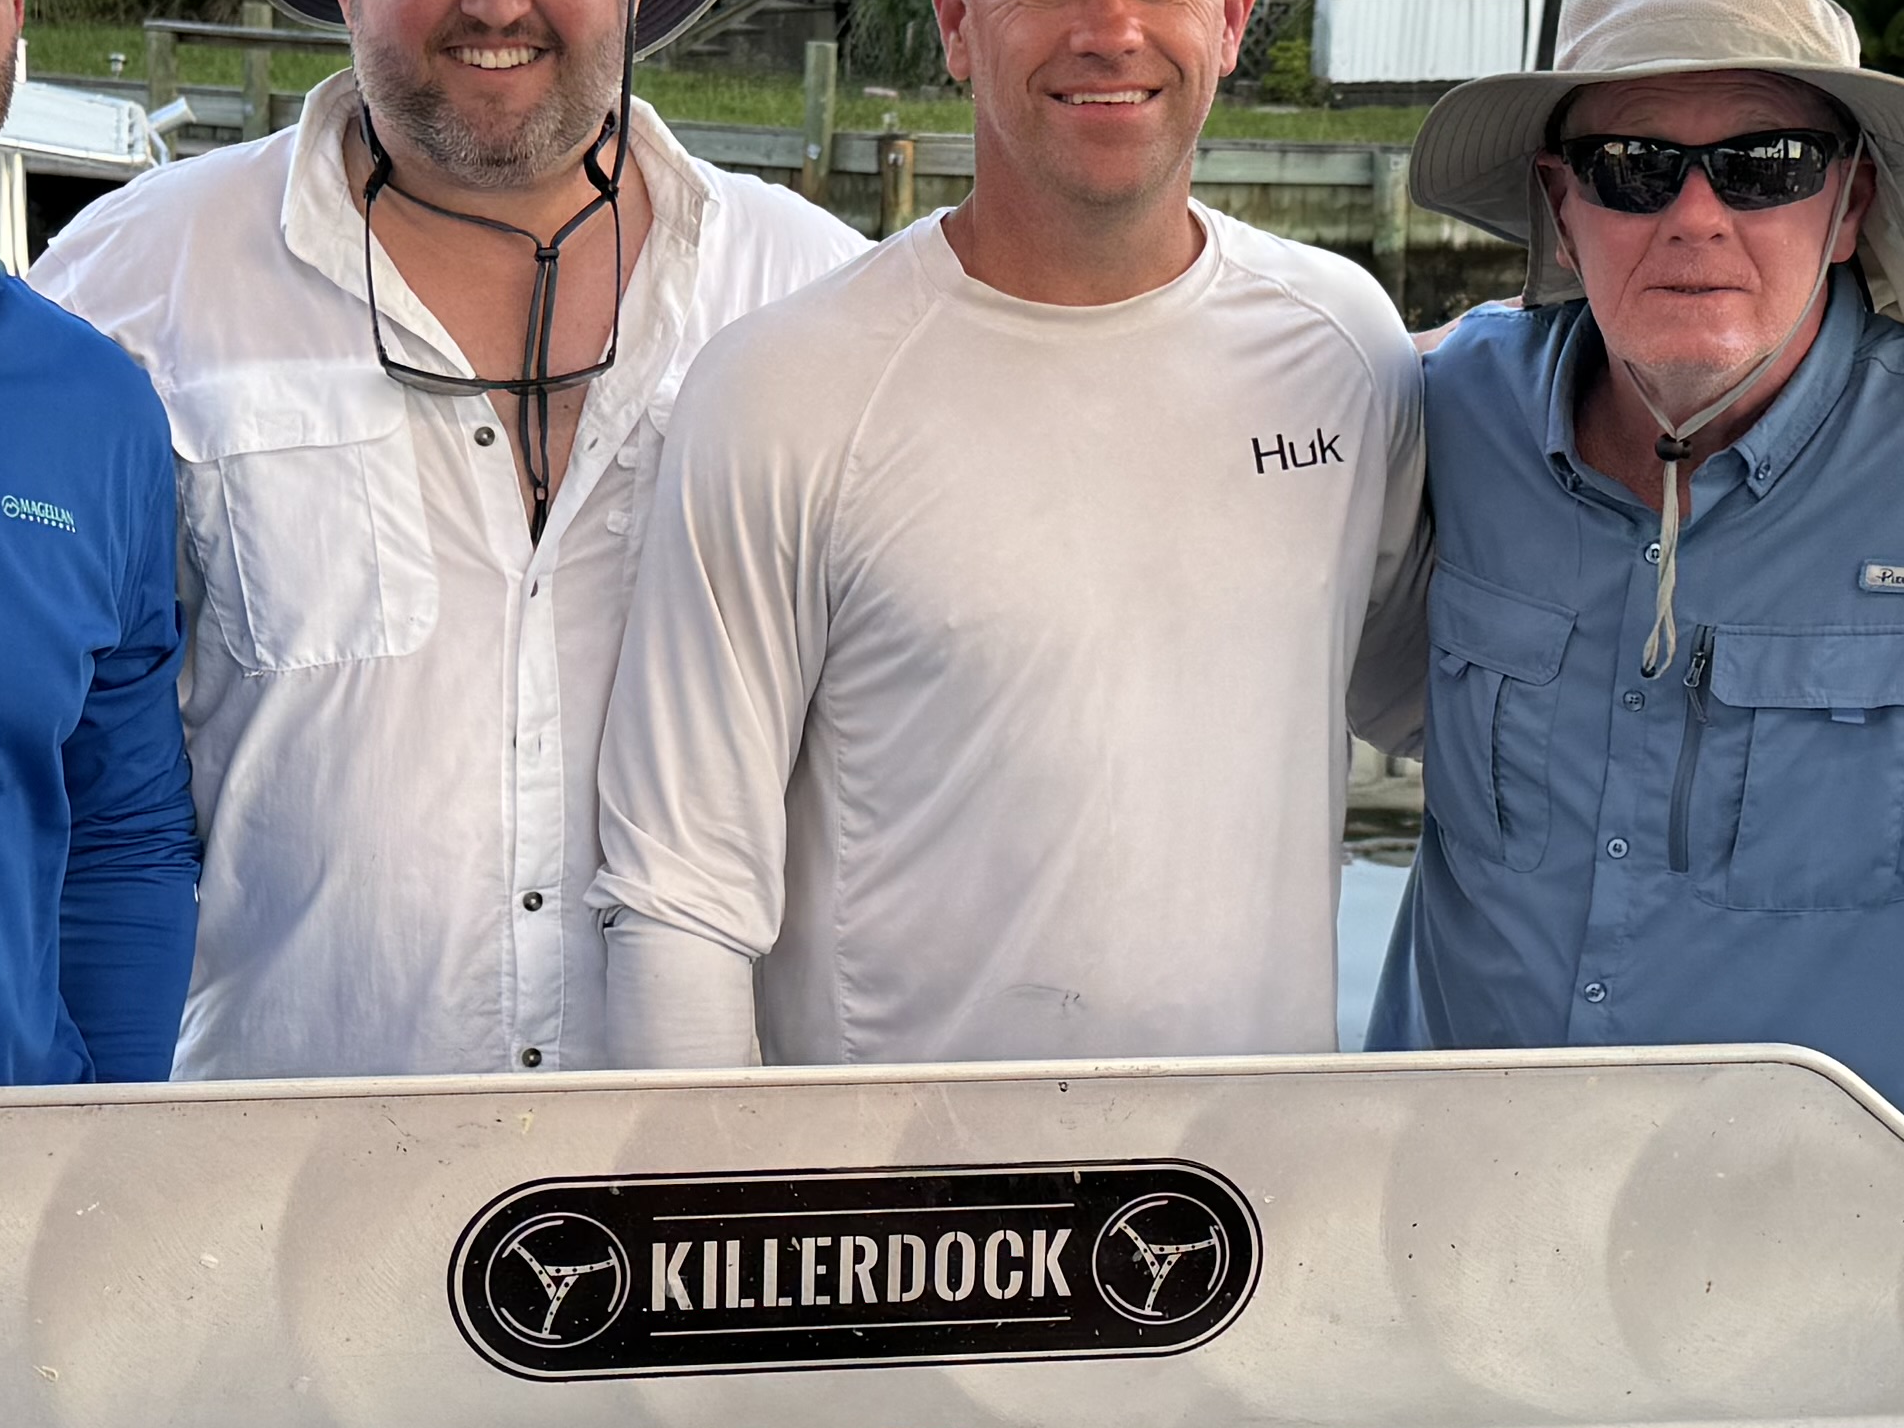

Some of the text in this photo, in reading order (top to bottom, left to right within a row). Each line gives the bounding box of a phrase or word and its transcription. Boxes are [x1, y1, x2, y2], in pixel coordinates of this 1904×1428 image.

[1251, 428, 1344, 474] Huk
[19, 498, 75, 526] MAGELLAN
[652, 1228, 1072, 1312] KILLERDOCK
